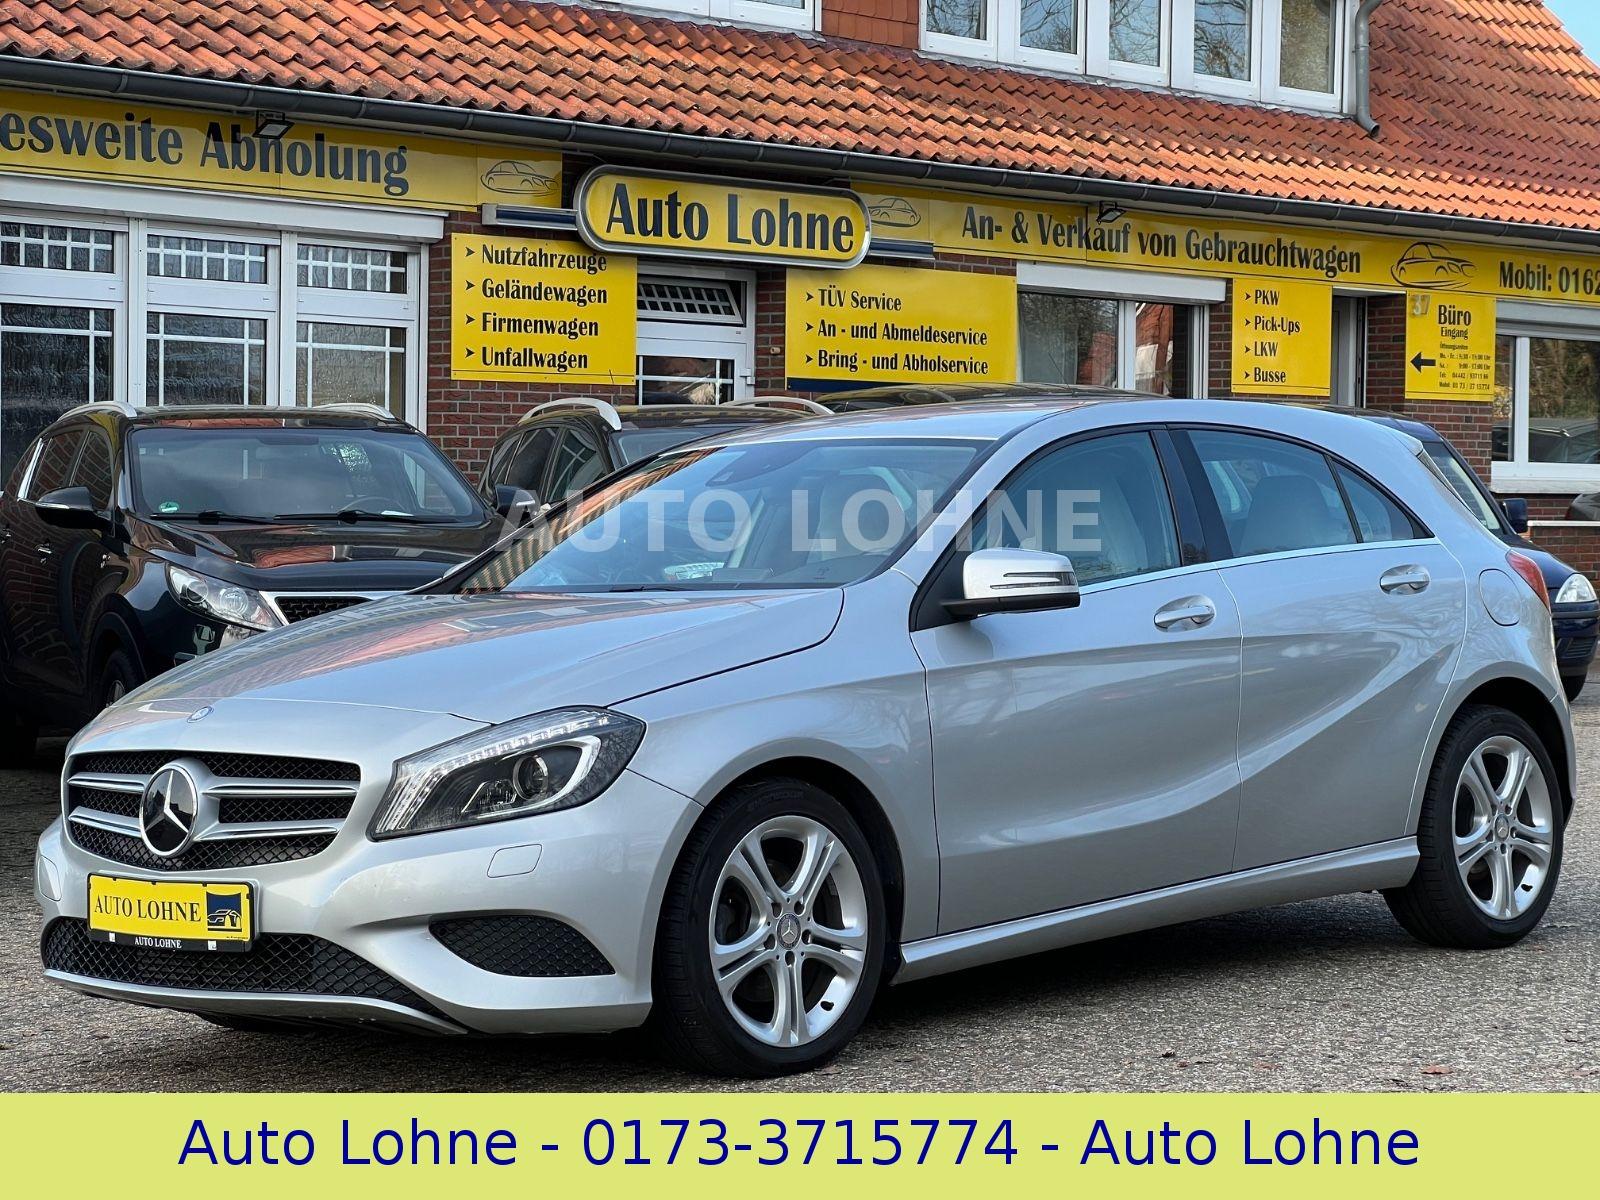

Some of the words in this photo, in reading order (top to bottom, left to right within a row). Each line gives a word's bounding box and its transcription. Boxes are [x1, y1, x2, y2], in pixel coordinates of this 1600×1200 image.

[0, 112, 183, 165] esweite
[200, 121, 408, 197] Abholung
[606, 183, 709, 241] Auto
[727, 193, 854, 253] Lohne
[962, 206, 1003, 241] An-
[1011, 211, 1029, 244] &
[1037, 212, 1131, 254] Verkauf
[1138, 232, 1177, 258] von
[1185, 228, 1361, 279] Gebrauchtwagen
[481, 244, 608, 275] Nutzfahrzeuge
[1499, 261, 1552, 292] Mobil:
[481, 278, 608, 307] Geländewagen
[818, 284, 847, 307] TÜV
[850, 290, 902, 311] Service
[1254, 289, 1281, 306] PKW
[481, 311, 600, 340] Firmenwagen
[1254, 315, 1301, 334] Pick-Ups
[1438, 304, 1472, 326] Büro
[818, 319, 837, 338] An
[851, 322, 877, 340] und
[882, 325, 988, 346] Abmeldeservice
[1440, 327, 1469, 340] Eingang
[481, 346, 589, 372] Unfallwagen
[818, 350, 858, 372] Bring
[872, 353, 898, 371] und
[902, 353, 989, 374] Abholservice
[1254, 341, 1278, 358] LKW
[1254, 367, 1287, 383] Busse
[94, 894, 133, 918] AUTO
[138, 899, 202, 922] LOHNE
[134, 936, 154, 947] AUTO
[155, 938, 182, 949] LOHNE
